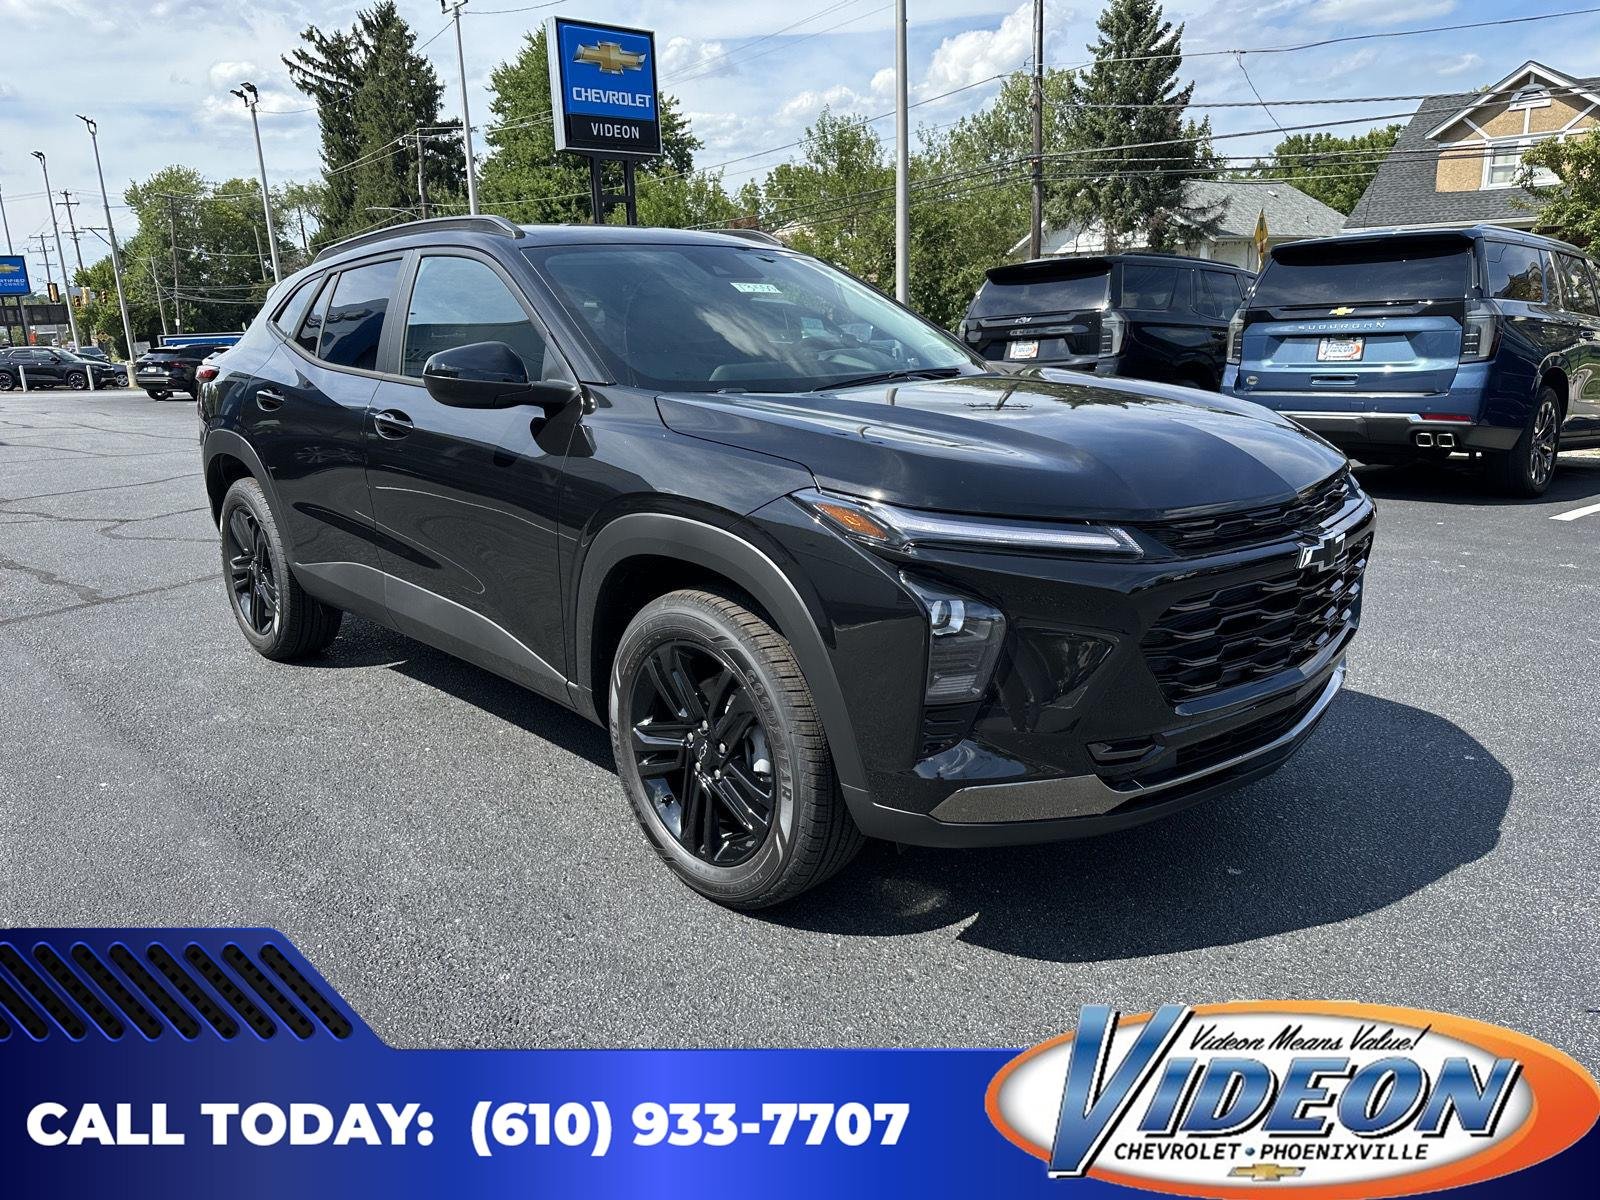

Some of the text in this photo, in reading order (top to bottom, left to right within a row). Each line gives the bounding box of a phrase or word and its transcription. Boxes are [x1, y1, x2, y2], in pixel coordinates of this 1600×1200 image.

[572, 87, 651, 108] CHEVROLET
[590, 122, 640, 139] VIDEON
[1298, 321, 1386, 330] SUBURBAN
